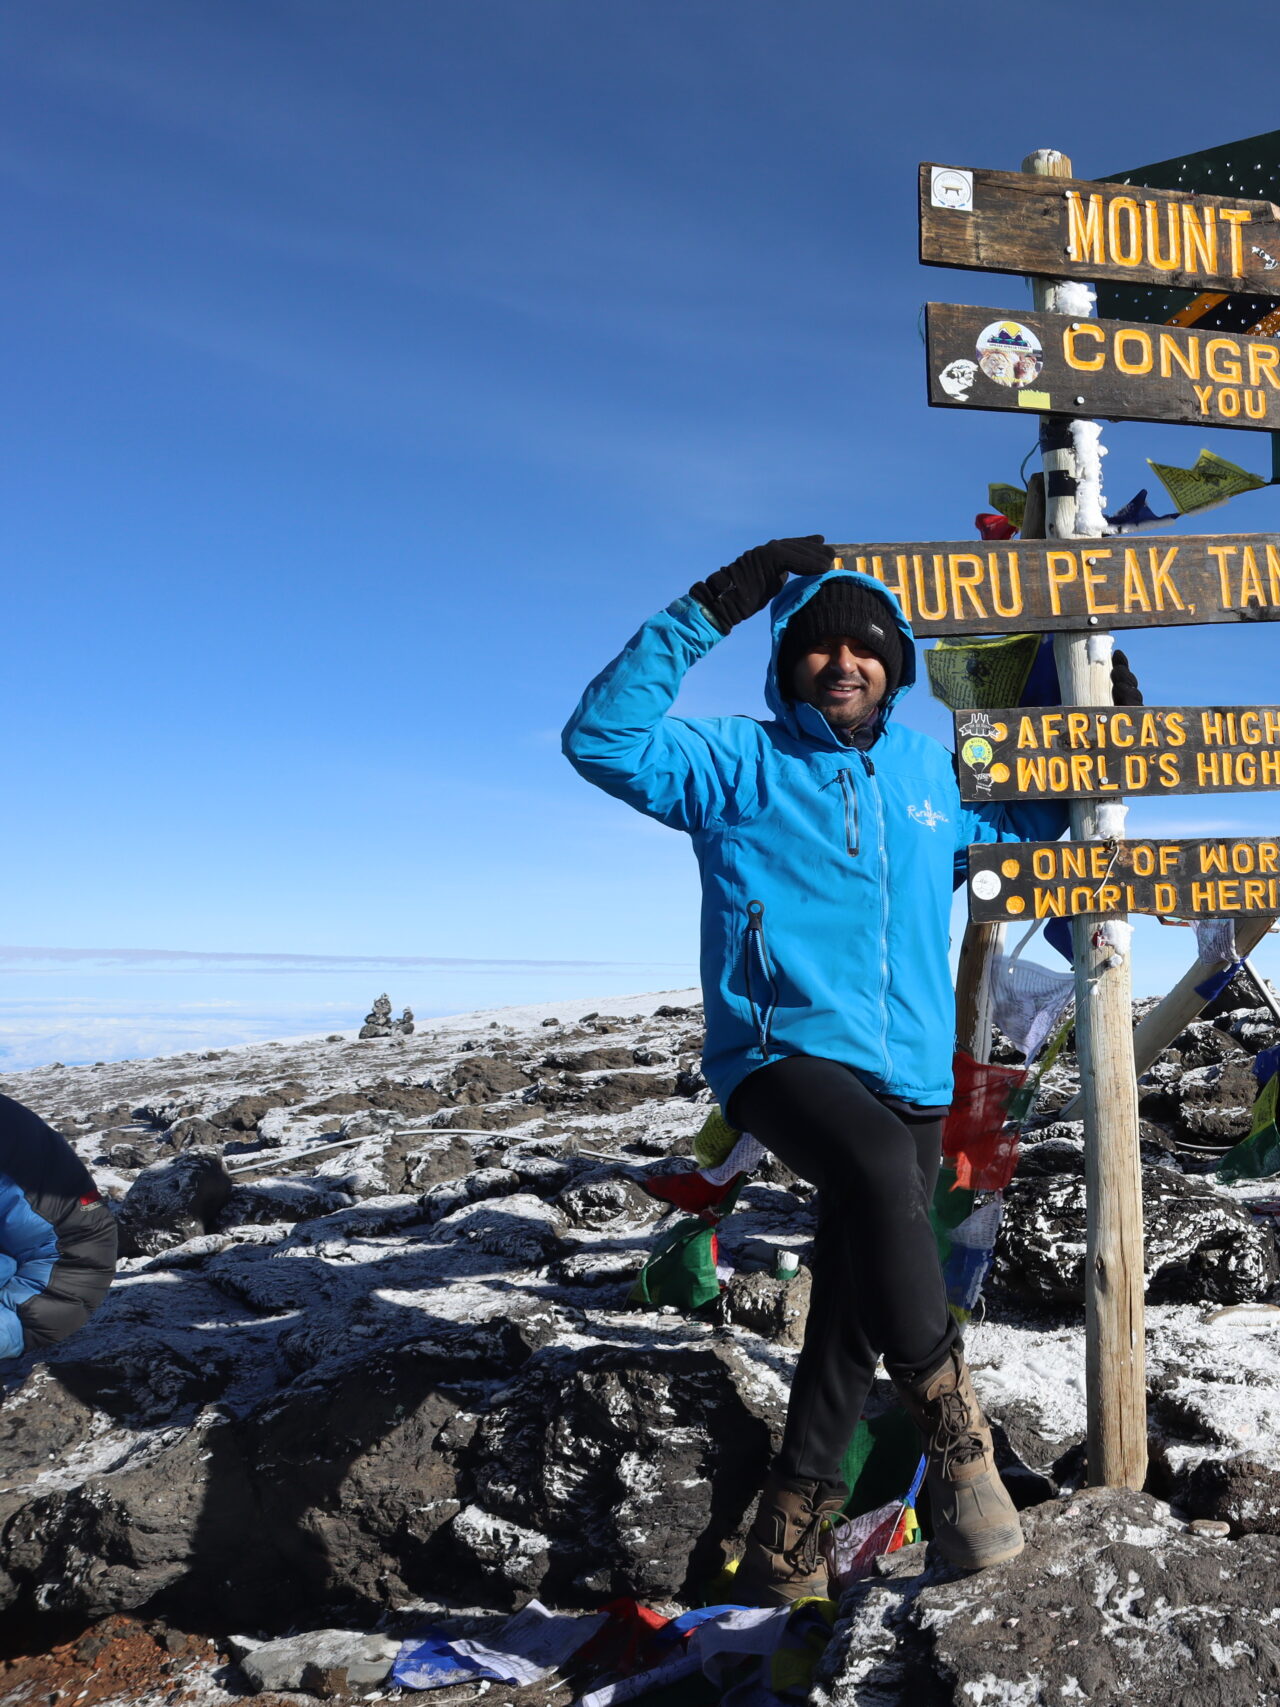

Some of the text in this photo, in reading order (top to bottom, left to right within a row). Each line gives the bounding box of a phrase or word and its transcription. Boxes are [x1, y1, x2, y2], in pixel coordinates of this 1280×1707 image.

[1068, 191, 1252, 278] MOUNT
[1194, 385, 1267, 419] YOU
[834, 554, 1023, 621] HURU
[1047, 547, 1196, 615] PEAK,
[1019, 713, 1186, 748] AFRICA'S
[1017, 753, 1180, 792] WORLD'S
[1033, 847, 1114, 881] ONE
[1131, 846, 1179, 876] OF
[1034, 883, 1176, 919] WORLD
